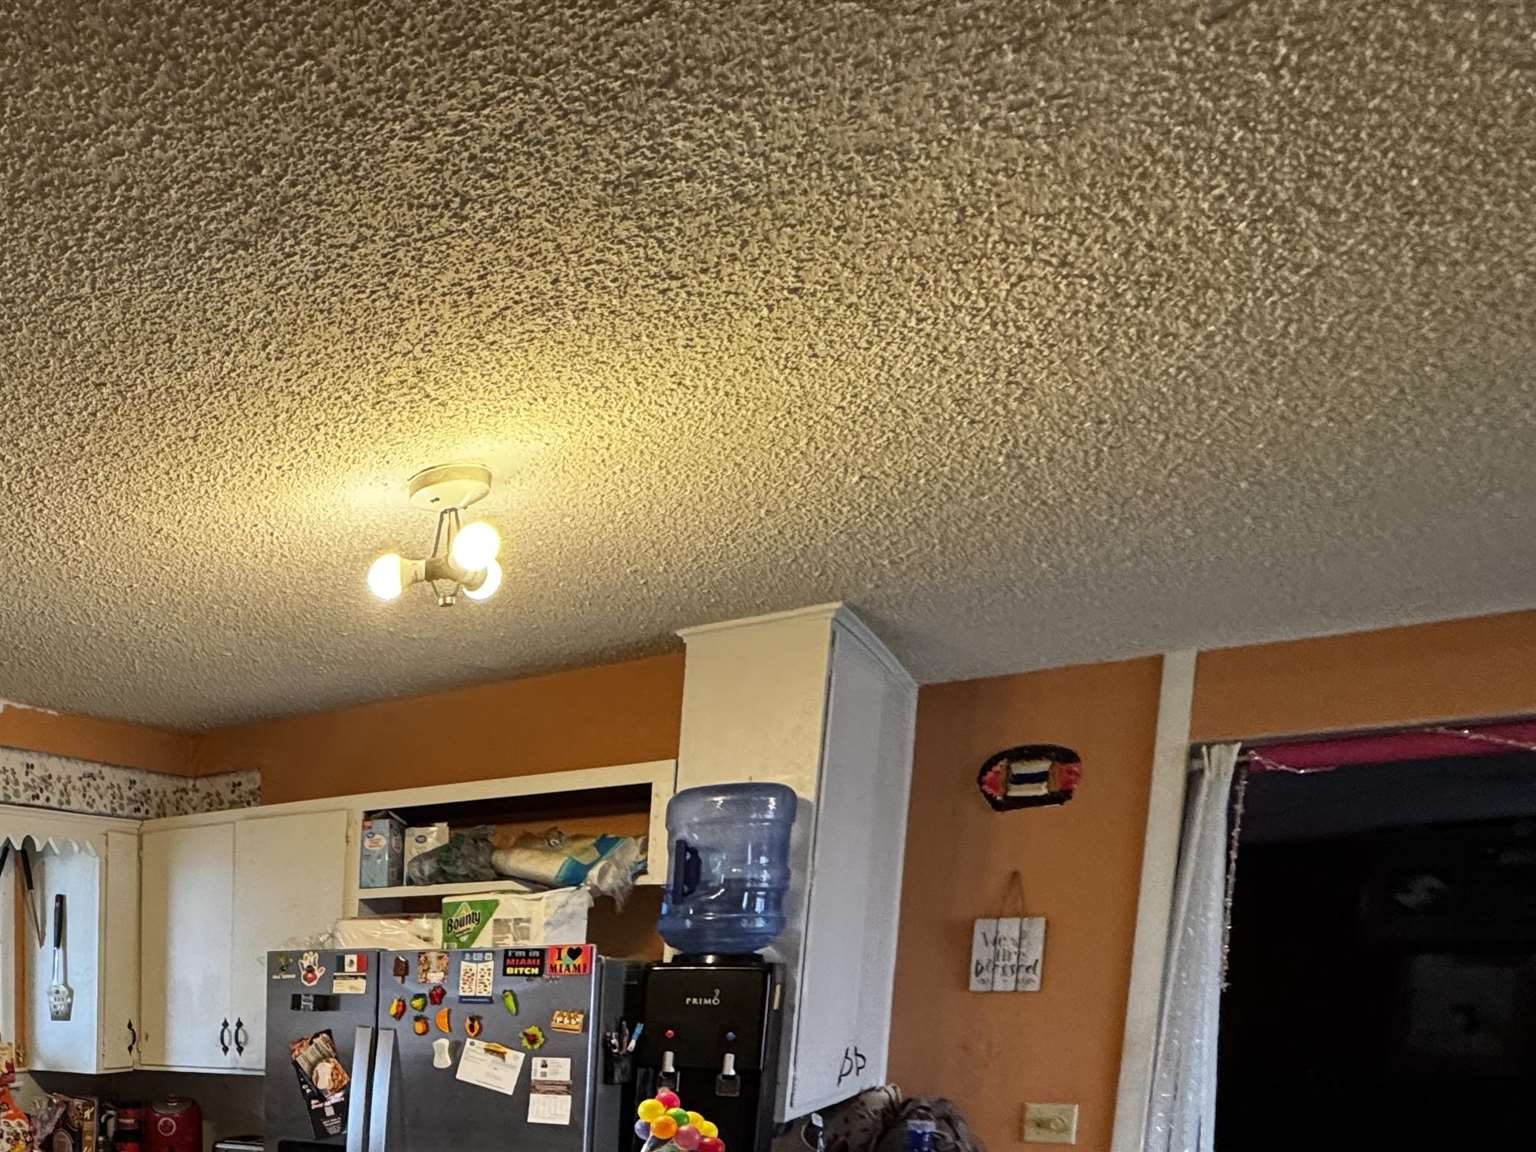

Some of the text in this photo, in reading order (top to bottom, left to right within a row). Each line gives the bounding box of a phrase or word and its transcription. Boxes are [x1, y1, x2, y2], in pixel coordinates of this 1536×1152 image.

[447, 911, 481, 933] Bounty
[508, 949, 540, 957] I'm in
[557, 948, 562, 960] I
[506, 967, 540, 975] BITCH
[549, 963, 587, 973] MIAMI
[686, 993, 720, 1005] PRIMO
